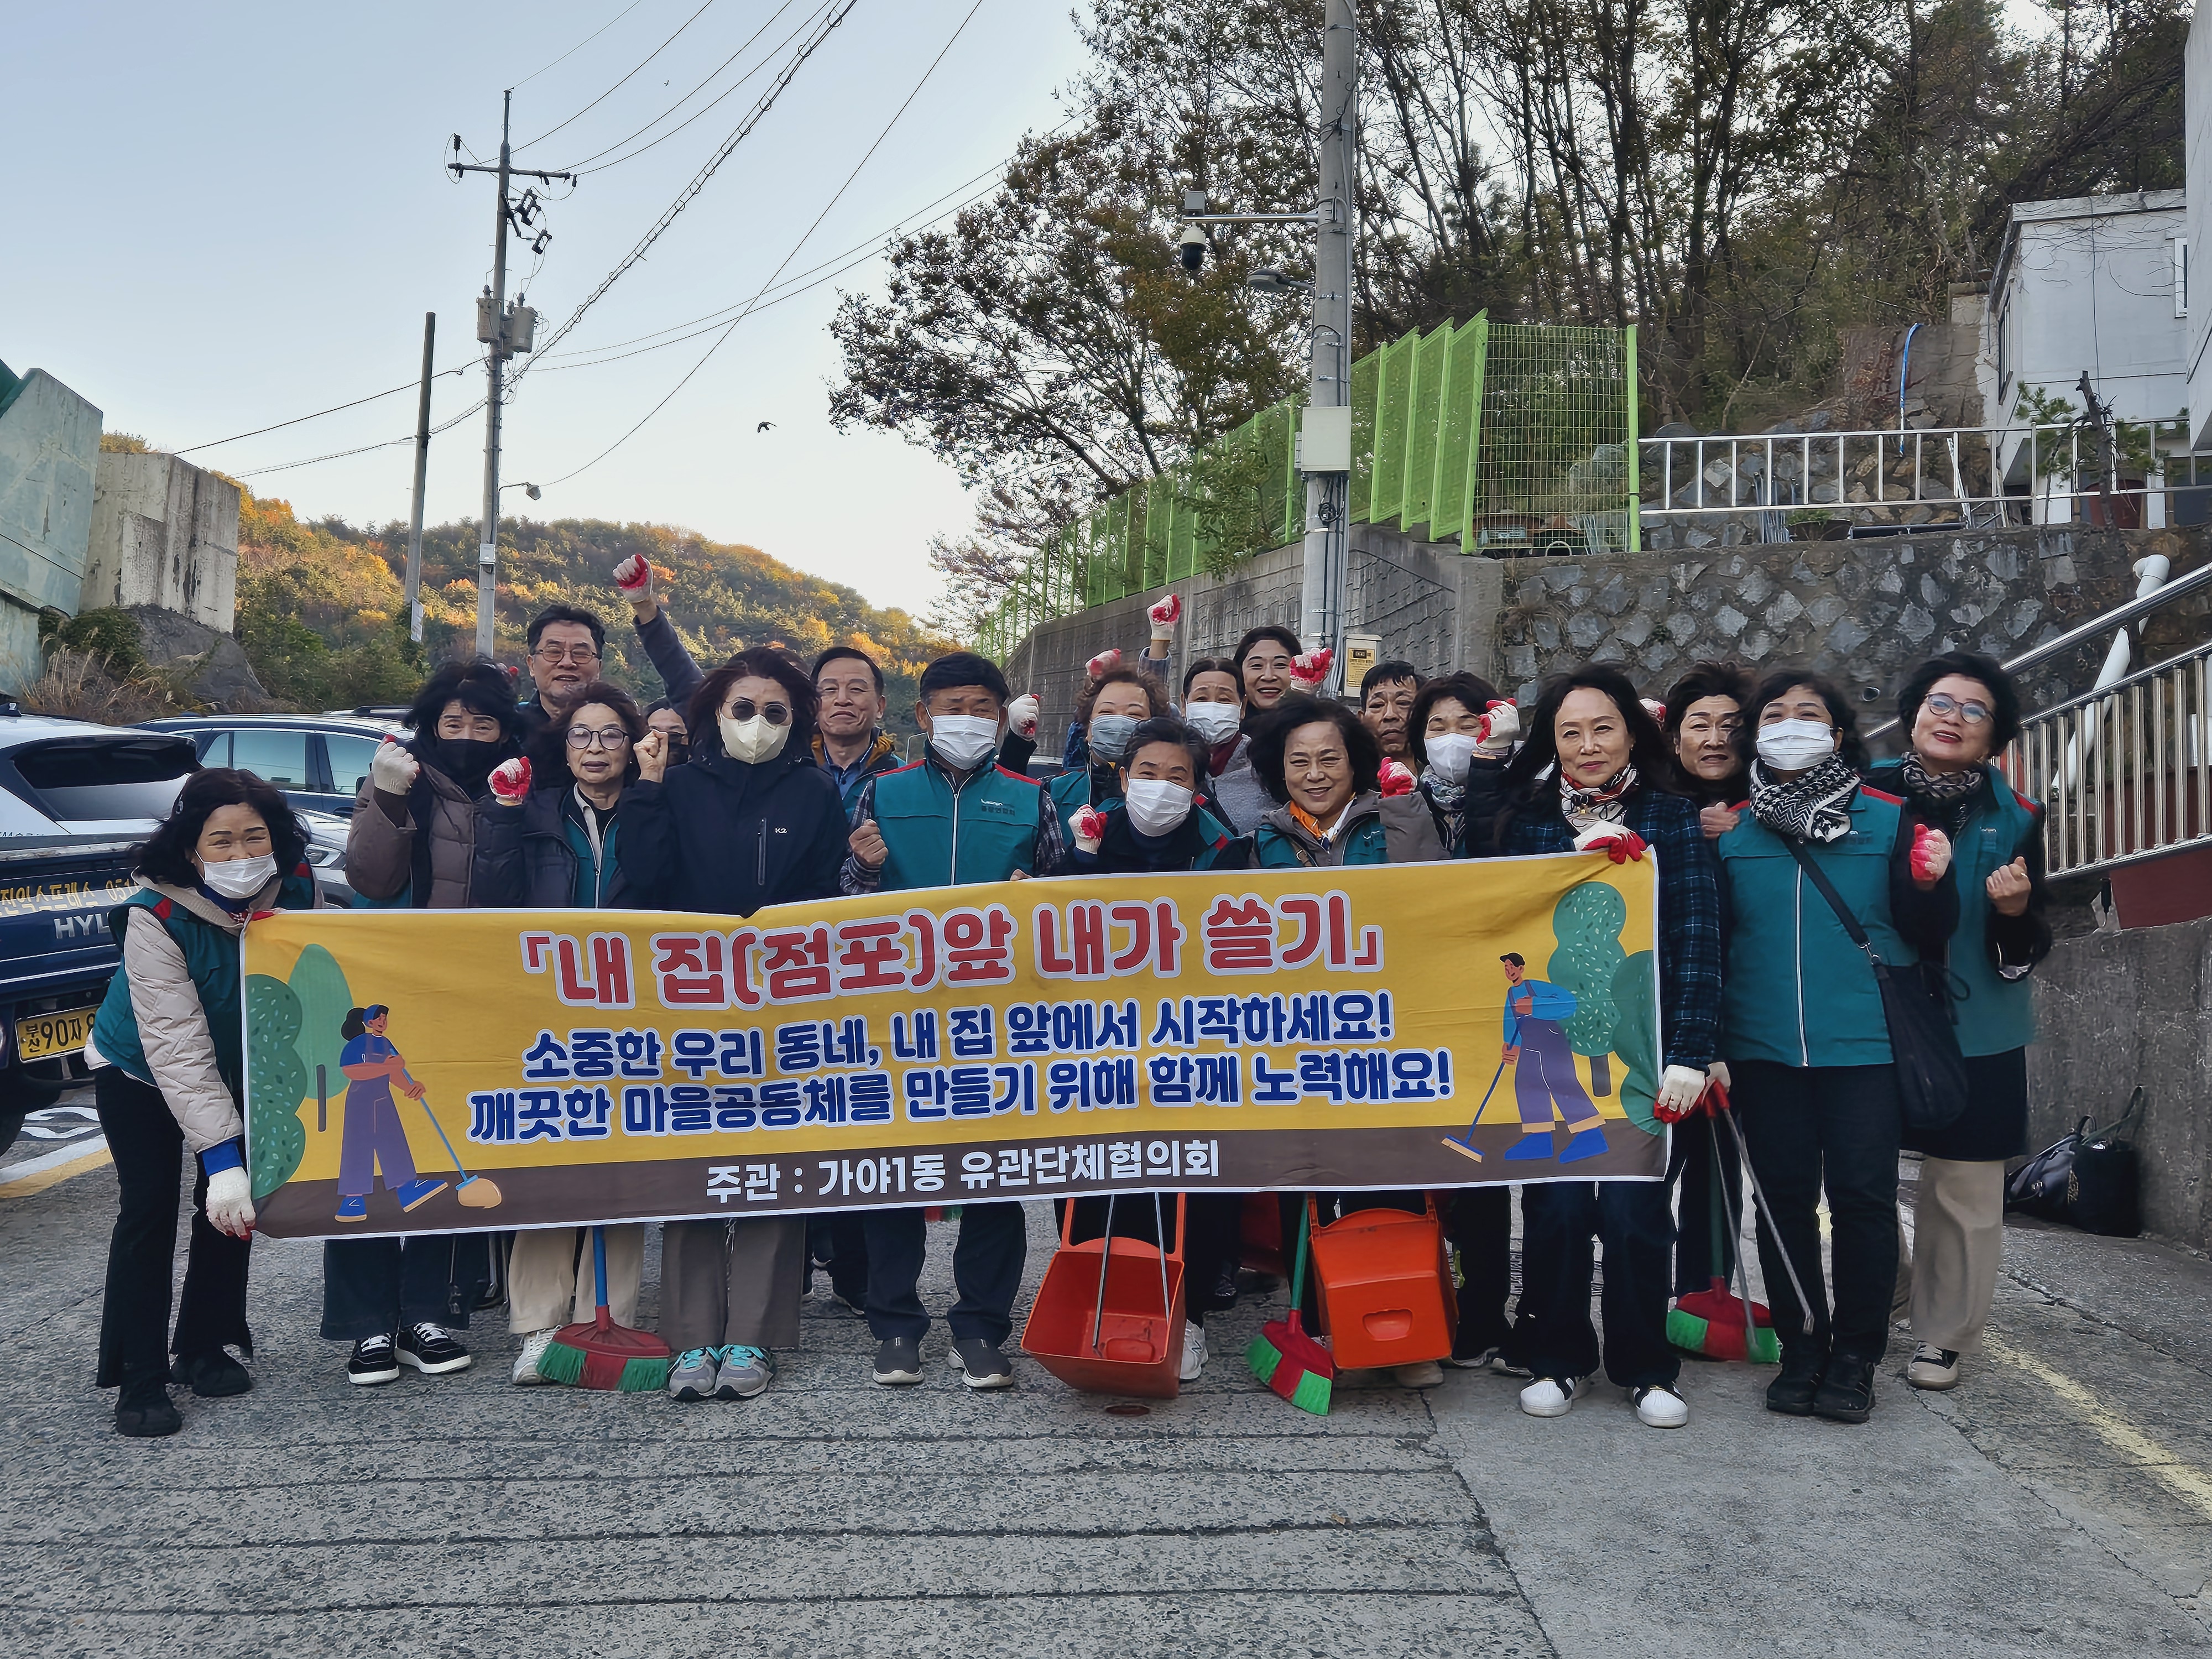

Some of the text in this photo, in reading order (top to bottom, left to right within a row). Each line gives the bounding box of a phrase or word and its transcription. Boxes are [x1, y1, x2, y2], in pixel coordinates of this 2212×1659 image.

[0, 882, 99, 916] 진익스프레스
[655, 909, 1013, 1006] 집(점포)앞
[1037, 902, 1183, 976] 내가
[524, 991, 1392, 1079] 소중한 우리 동네, 내 집 앞에서 시작하세요!
[469, 1049, 1452, 1142] 깨끗한 마을공동체를 만들기 위해 함께 노력해요!
[706, 1162, 781, 1204] 주관
[818, 1153, 946, 1197] 가야1동
[960, 1139, 1220, 1191] 유관단체협의회
